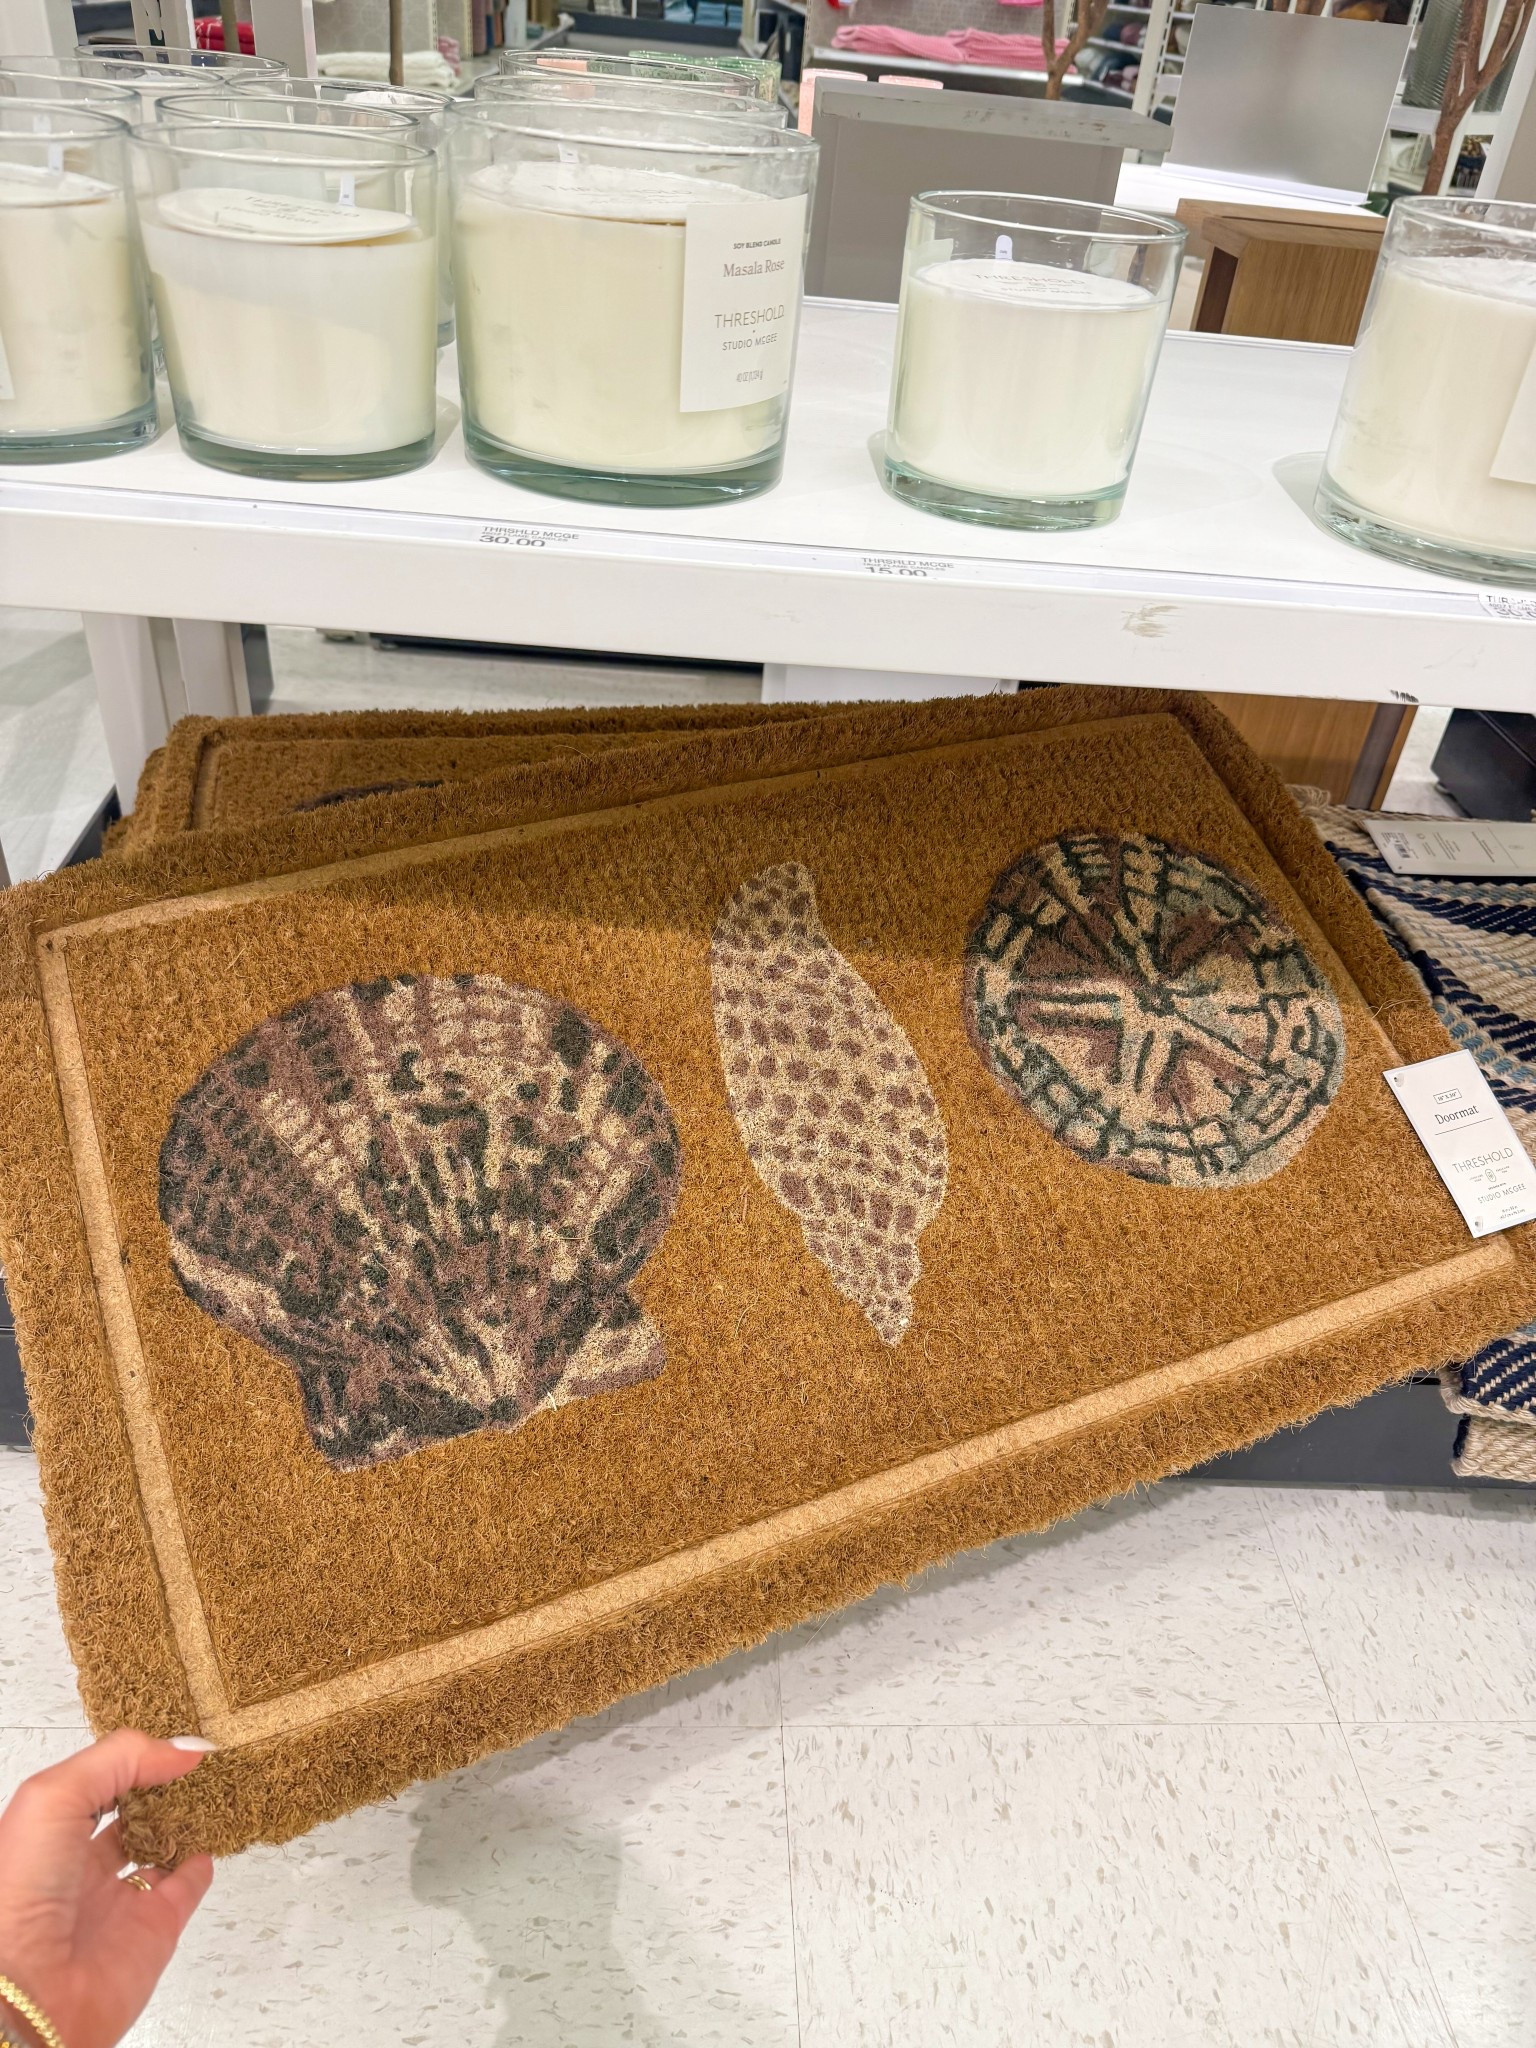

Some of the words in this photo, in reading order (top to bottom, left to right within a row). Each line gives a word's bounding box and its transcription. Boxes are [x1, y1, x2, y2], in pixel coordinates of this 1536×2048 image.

[732, 242, 745, 250] SOY
[745, 240, 763, 249] BLEND
[763, 237, 782, 247] CANDLE
[723, 260, 764, 278] Masala
[764, 258, 786, 273] Rose
[722, 337, 753, 351] STUDIO
[482, 526, 540, 537] THRSHLD
[542, 531, 580, 540] MCGE
[479, 534, 546, 547] 30.00
[861, 557, 917, 567] THRSHLD
[919, 561, 955, 569] MCGE
[1434, 1105, 1479, 1125] Doormat
[1452, 1147, 1513, 1173] THRESHOLD
[1477, 1191, 1502, 1204] STUDIO
